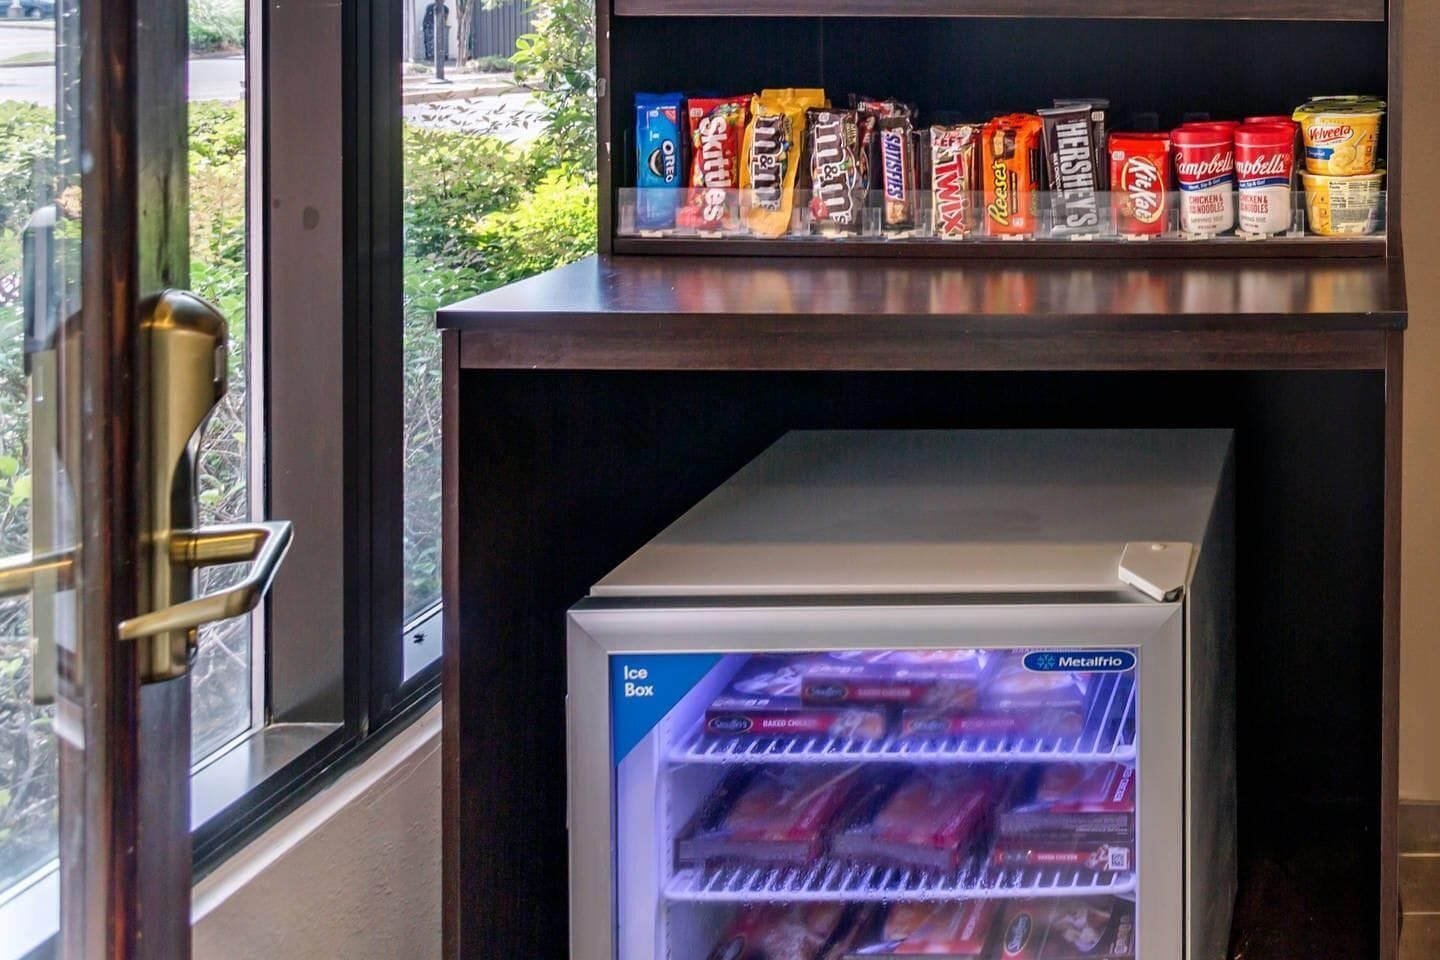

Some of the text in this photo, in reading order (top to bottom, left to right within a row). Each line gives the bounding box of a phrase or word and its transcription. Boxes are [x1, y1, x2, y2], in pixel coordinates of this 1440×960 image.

[1310, 125, 1352, 140] Velveeta
[662, 140, 677, 183] OREO
[700, 116, 732, 222] Skittles
[1236, 154, 1285, 178] mpbell's
[1056, 121, 1098, 228] HERSHEY'S
[1189, 195, 1218, 205] CHICKEN
[1197, 203, 1225, 214] NOODLES
[1059, 656, 1122, 667] Metalfrio
[624, 665, 648, 680] Ice
[625, 682, 654, 697] Box
